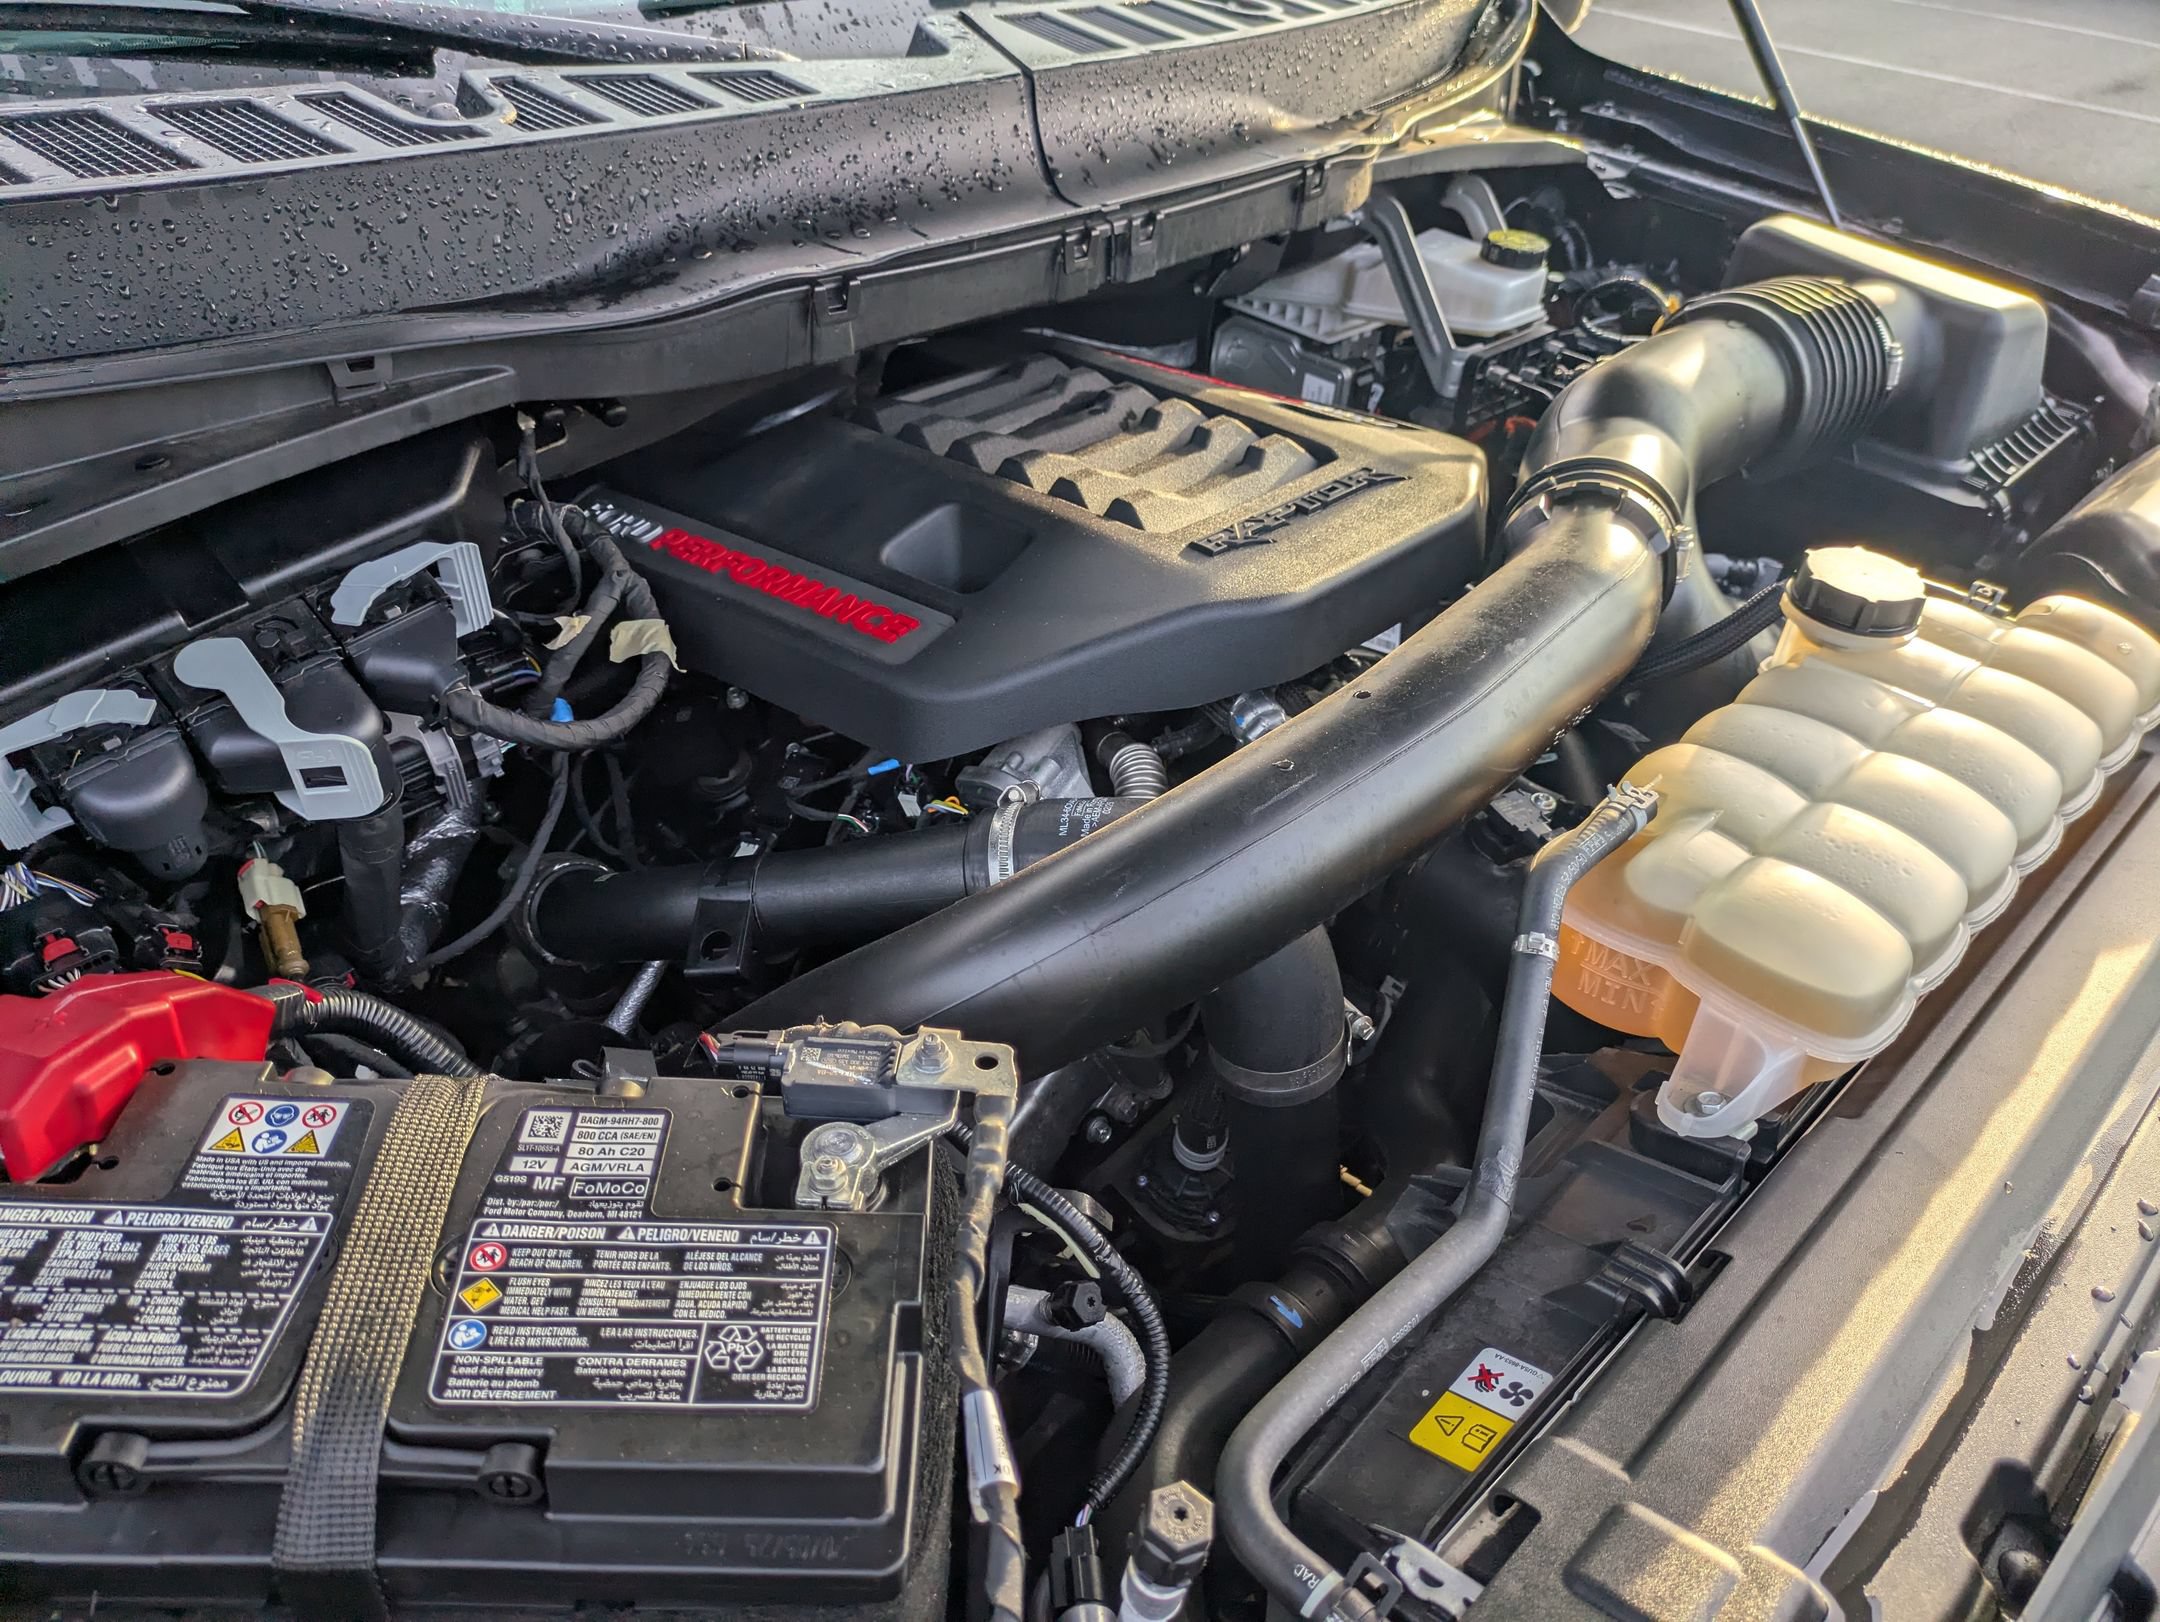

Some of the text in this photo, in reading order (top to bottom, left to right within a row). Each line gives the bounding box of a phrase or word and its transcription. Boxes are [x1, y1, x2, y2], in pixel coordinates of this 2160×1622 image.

[1185, 465, 1412, 557] RAPTOR
[649, 527, 921, 644] PERFORMANCE
[1586, 941, 1652, 986] MAX
[1577, 970, 1641, 1014] MIN
[576, 1130, 657, 1141] 800 CCA (SAE/EN)
[577, 1147, 645, 1156] 80 Ah C20
[522, 1159, 548, 1169] 12V
[570, 1163, 645, 1172] AGM/VRLA
[533, 1177, 566, 1191] MF
[573, 1181, 645, 1195] FoMoCo
[487, 1198, 504, 1206] Dist.
[484, 1207, 642, 1218] Ford Motor Company, Dearborn, MI 48121
[125, 1212, 235, 1229] PELIGRO/VENENO
[62, 1230, 123, 1242] SE PROTÉGER
[501, 1224, 740, 1242] DANGER/POISON PELIGRO/VENENO
[160, 1234, 218, 1244] PROTEJA LOS
[150, 1253, 206, 1262] EXPLOSIVOS
[512, 1248, 572, 1258] KEEP OUT OF THE
[617, 1251, 638, 1259] HORS
[685, 1251, 763, 1262] ALÉJESE DEL ALCANCE
[509, 1259, 583, 1268] REACH OF CHILDREN.
[592, 1260, 672, 1270] PORTÉE DES ENFANTS.
[683, 1262, 733, 1272] DE LOS NIÑOS.
[509, 1278, 550, 1286] FLUSH EYES
[680, 1281, 715, 1289] ENJUAGUE
[728, 1282, 747, 1290] OJOS
[500, 1307, 569, 1316] MEDICAL HELP FAST.
[492, 1326, 578, 1336] READ INSTRUCTIONS.
[601, 1328, 698, 1338] LEA LAS INSTRUCCIONES.
[489, 1336, 589, 1347] LIRE LES INSTRUCTIONS.
[727, 1343, 744, 1352] Pb
[455, 1356, 543, 1365] NON-SPILLABLE
[577, 1358, 687, 1367] CONTRA DERRAMES
[452, 1366, 544, 1377] Lead Acid Battery
[59, 1372, 141, 1386] NO LA ABRA.
[448, 1378, 539, 1388] Batterie au plomb
[443, 1390, 557, 1399] ANTI DÉVERSEMENT
[1295, 1564, 1320, 1589] RAD
